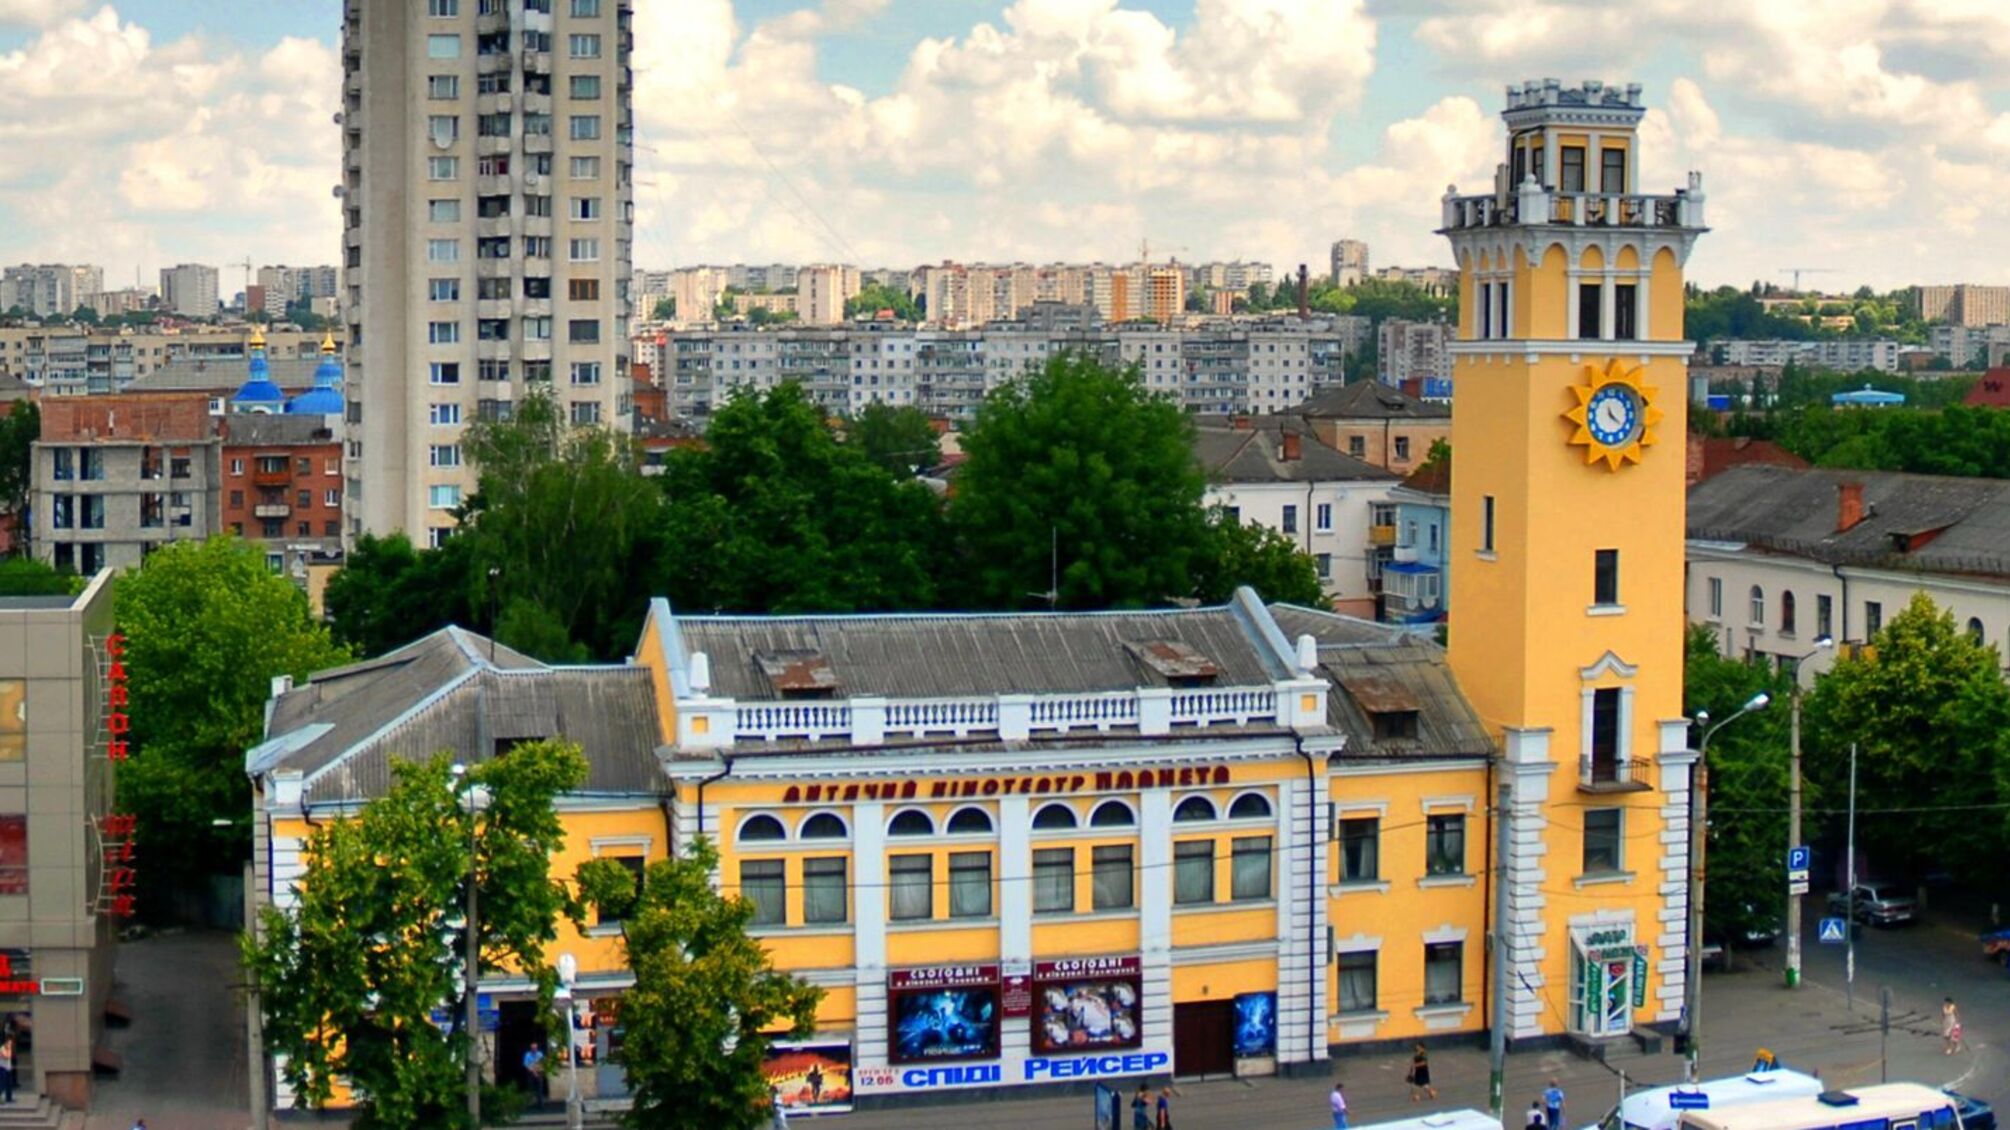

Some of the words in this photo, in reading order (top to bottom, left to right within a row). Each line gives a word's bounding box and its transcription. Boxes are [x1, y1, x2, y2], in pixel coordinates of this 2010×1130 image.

[106, 634, 128, 760] САЛОН
[931, 774, 1085, 798] КІНОТЕАТР
[1095, 765, 1230, 791] ПЛАНЕТА
[1793, 851, 1803, 866] P
[910, 967, 980, 979] СЬОГОДНІ
[1055, 957, 1122, 971] СЬОГОДНІ
[902, 1065, 1001, 1087] СПІДІ
[1024, 1052, 1168, 1080] РЕЙСЕР
